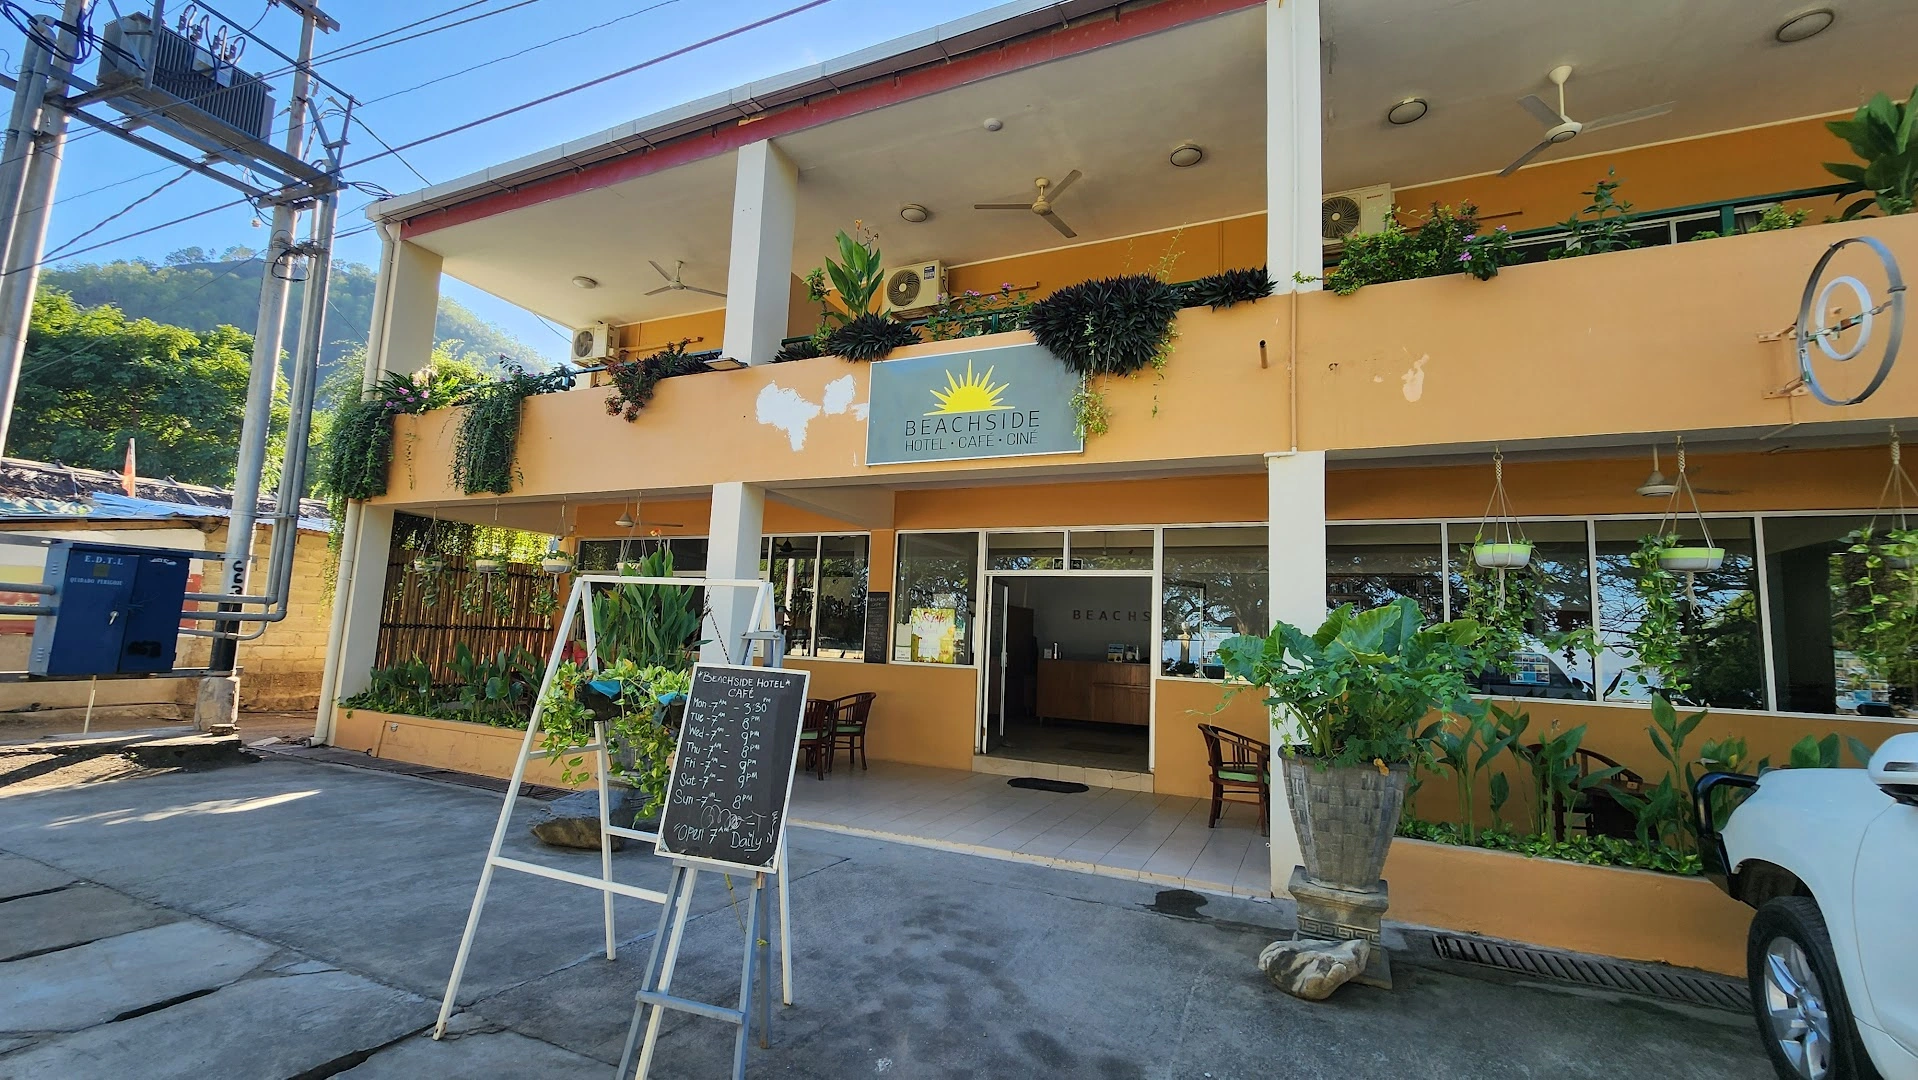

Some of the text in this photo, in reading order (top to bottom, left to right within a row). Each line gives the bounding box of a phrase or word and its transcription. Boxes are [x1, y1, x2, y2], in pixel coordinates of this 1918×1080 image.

[905, 410, 1040, 437] BEACHSIDE
[905, 430, 1039, 452] HOTEL CAFÉ CINÉ
[1072, 609, 1152, 622] BEACHS
[702, 671, 785, 689] BEACHSIDE HOTEL
[727, 687, 755, 699] CAFÉ
